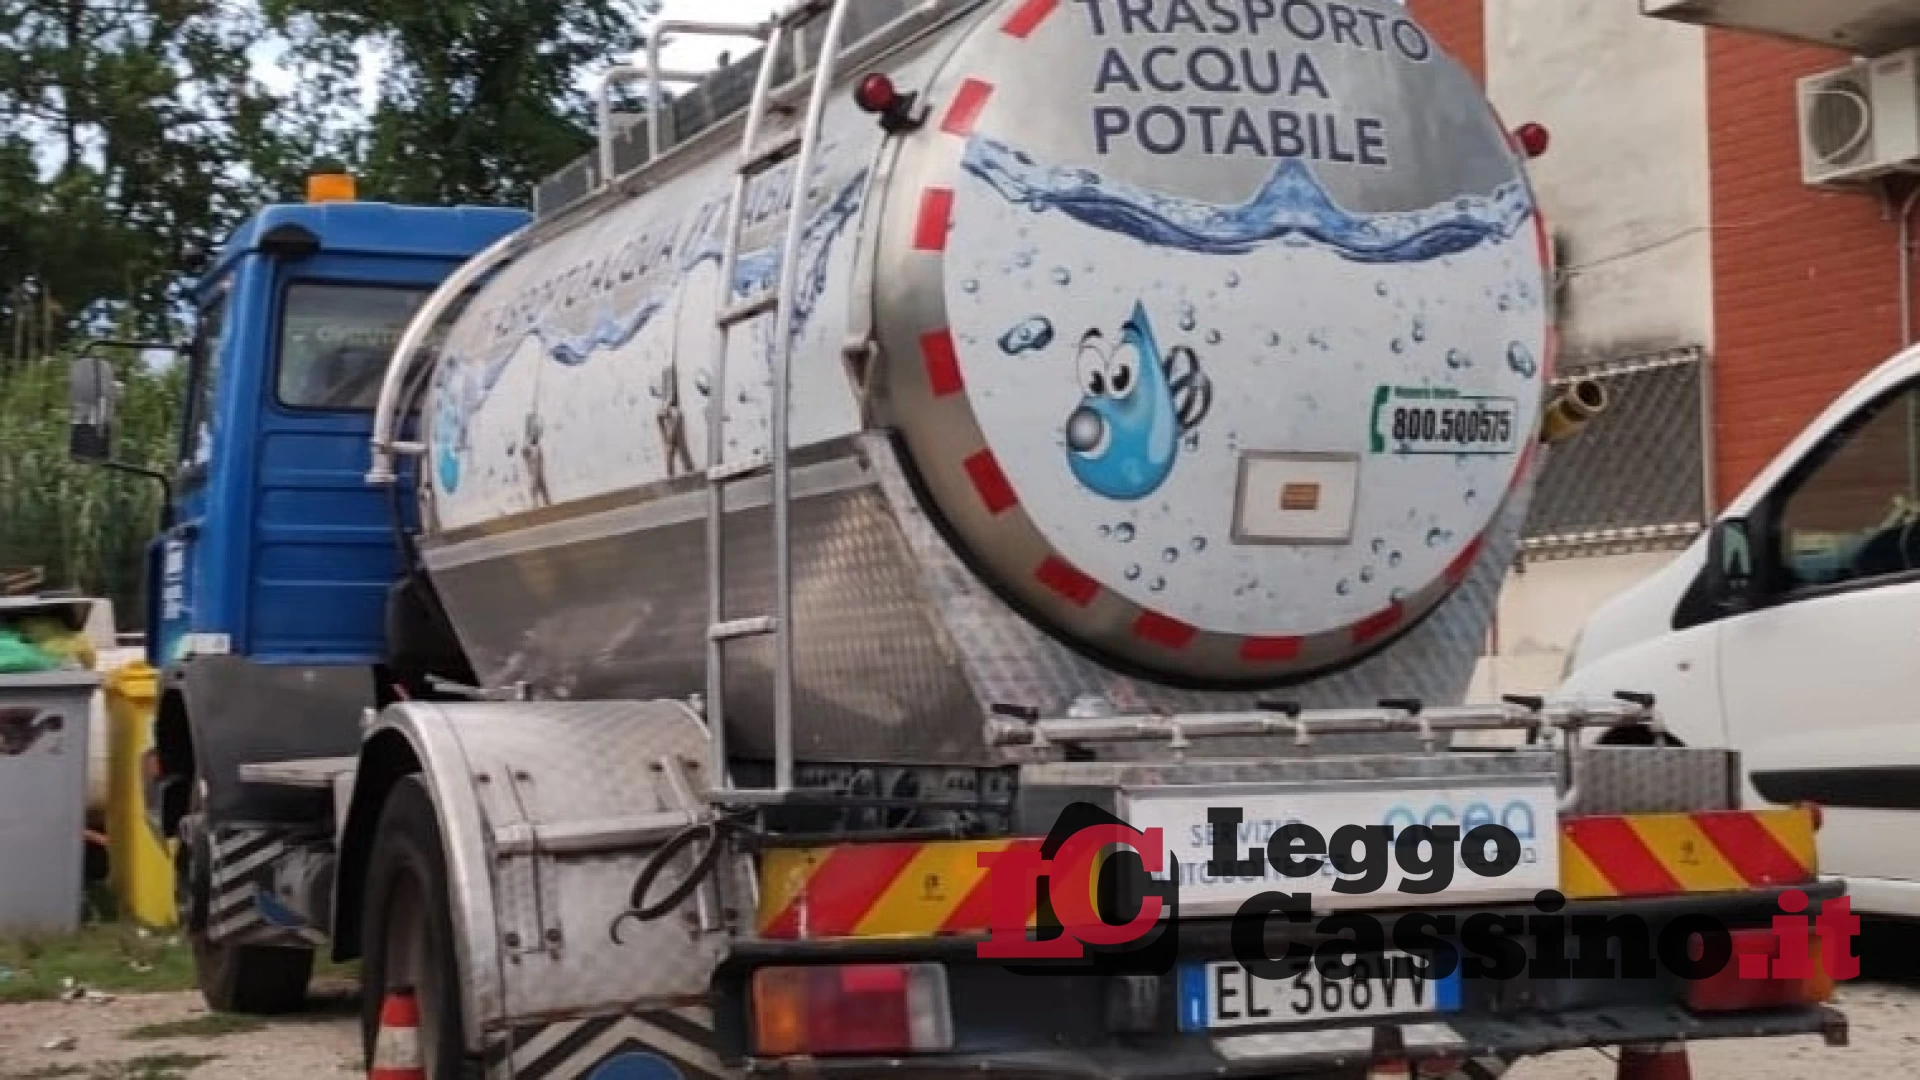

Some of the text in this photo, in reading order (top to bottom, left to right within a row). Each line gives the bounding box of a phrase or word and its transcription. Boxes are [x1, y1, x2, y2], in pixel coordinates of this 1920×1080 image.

[1074, 0, 1430, 61] TRASPORTO
[1094, 46, 1330, 98] ACQUA
[1093, 105, 1387, 165] POTABILE
[1217, 963, 1272, 1020] EL
